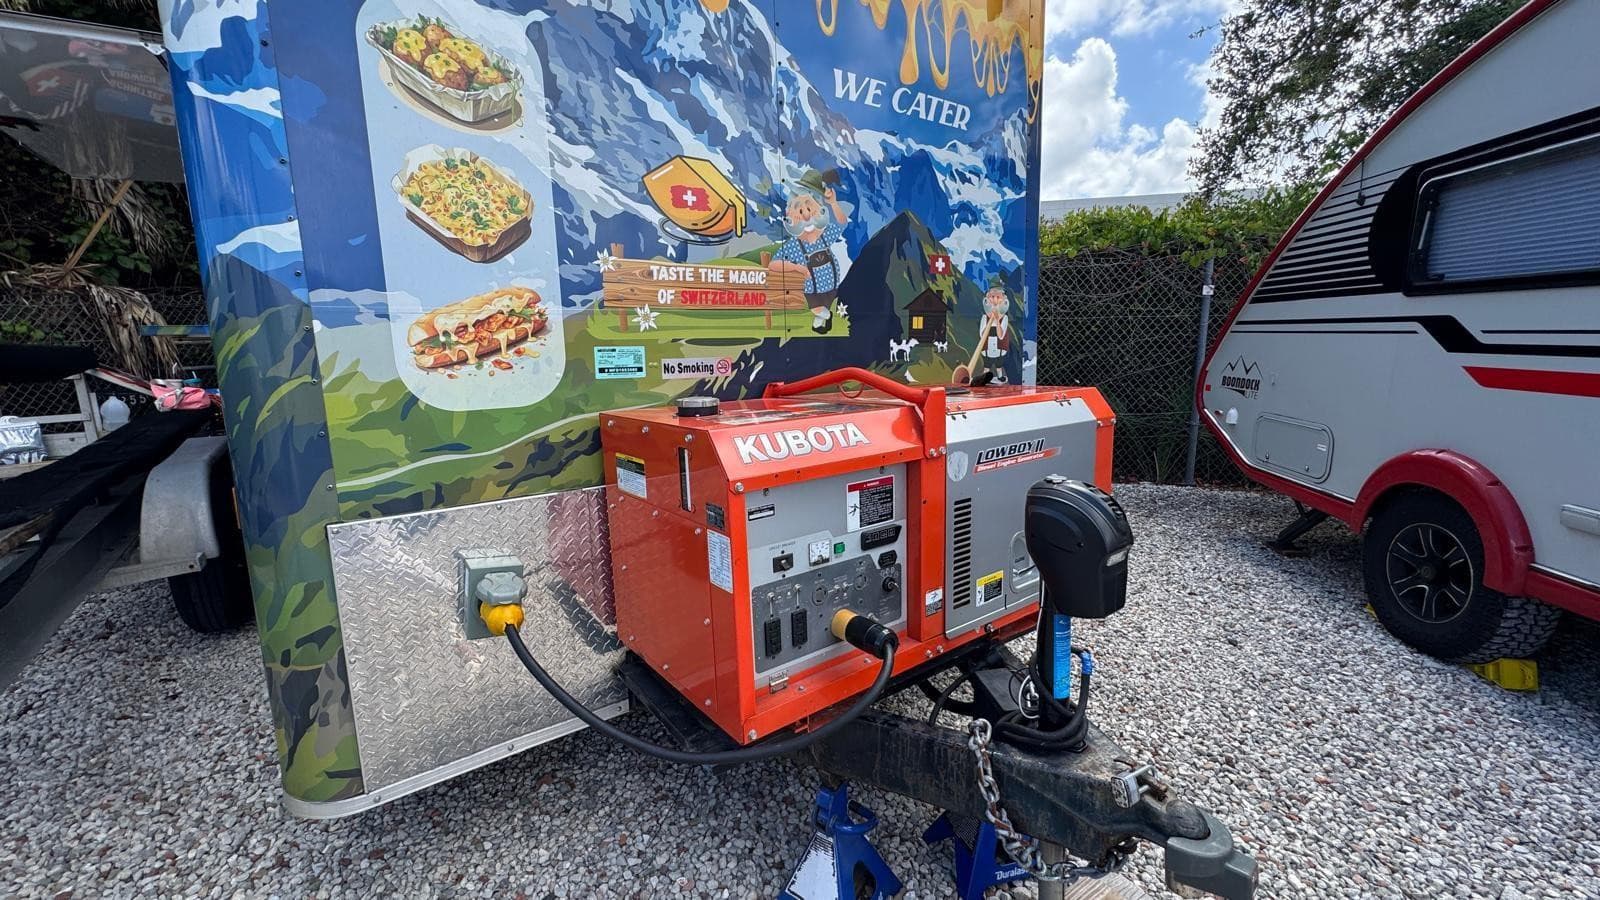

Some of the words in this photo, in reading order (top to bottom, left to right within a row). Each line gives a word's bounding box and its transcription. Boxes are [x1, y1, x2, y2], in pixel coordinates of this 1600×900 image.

[833, 68, 887, 108] WE
[892, 87, 971, 131] CATER
[650, 265, 695, 282] TASTE
[698, 268, 725, 283] THE
[729, 270, 767, 285] MAGIC
[657, 288, 676, 304] OF
[680, 289, 767, 306] SWITZERLAND
[663, 363, 675, 375] No
[677, 362, 714, 375] Smoking
[733, 422, 870, 465] KUBOTA
[975, 441, 1034, 466] LOWBOY
[995, 866, 1029, 880] Duralas
